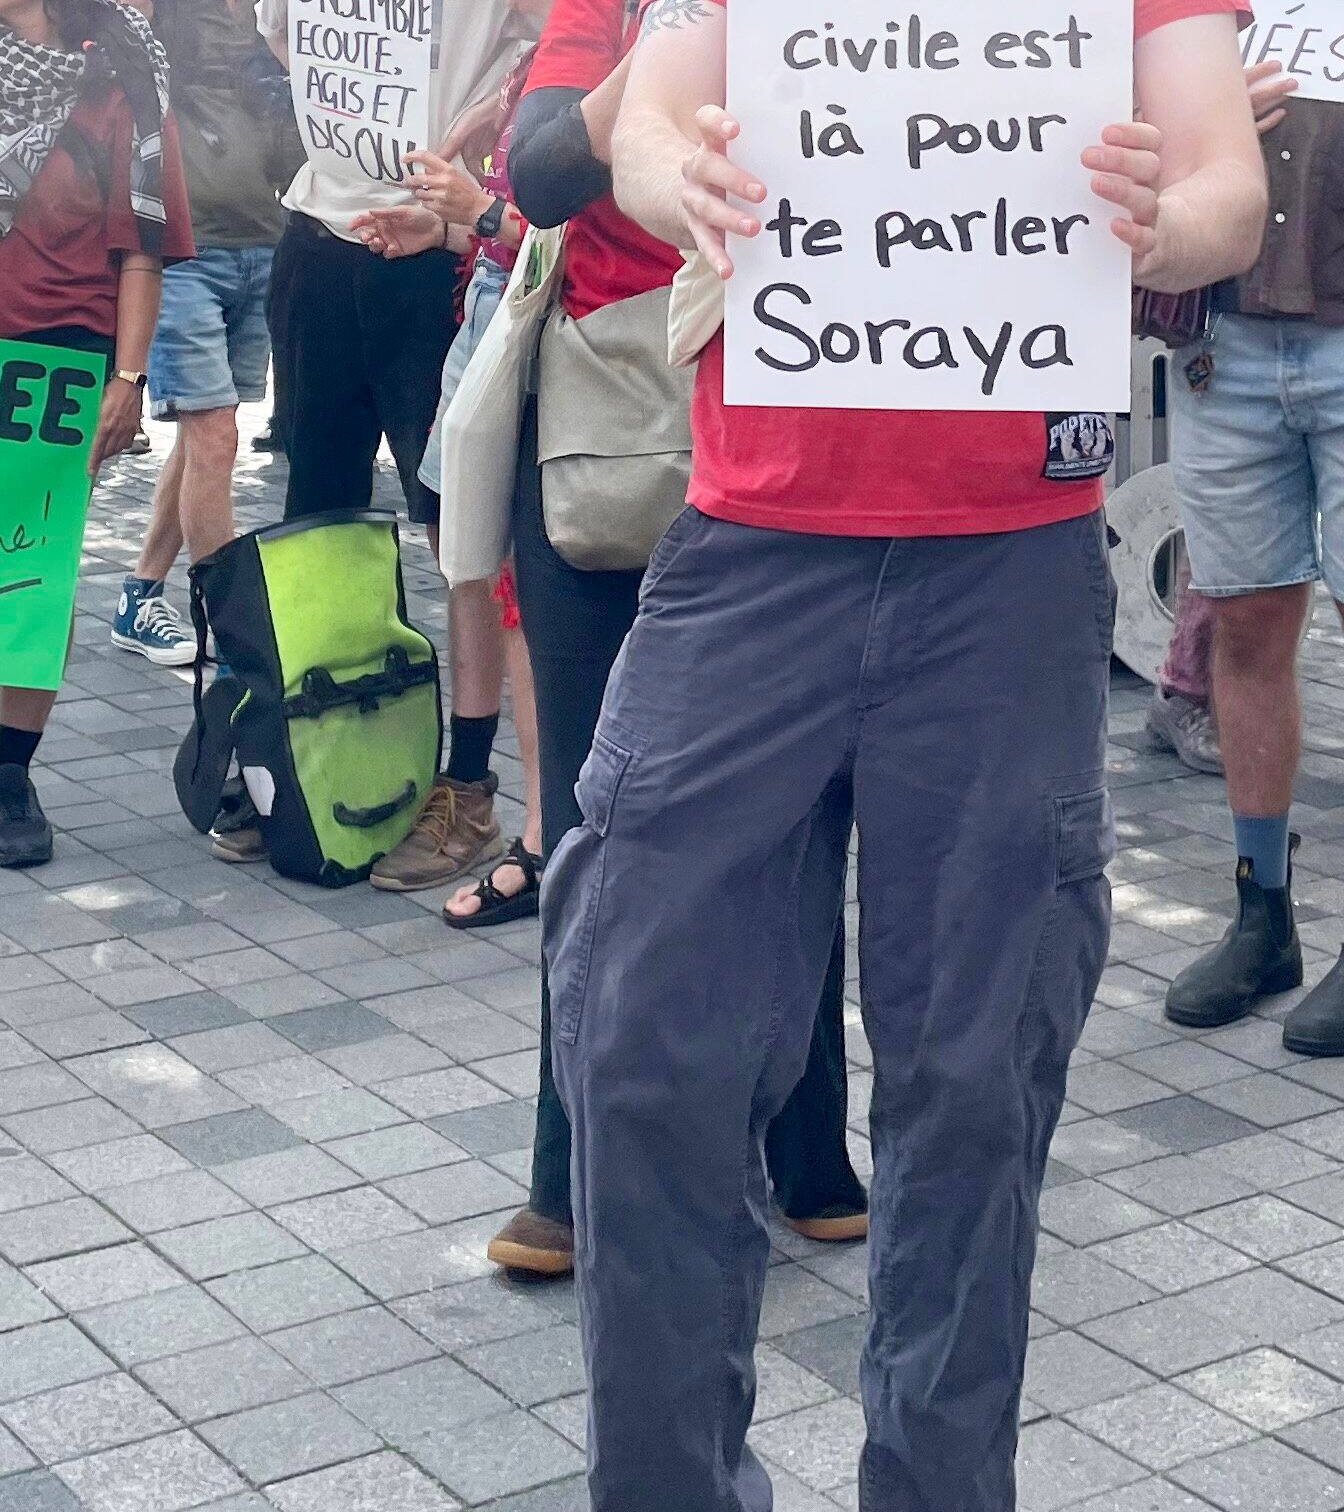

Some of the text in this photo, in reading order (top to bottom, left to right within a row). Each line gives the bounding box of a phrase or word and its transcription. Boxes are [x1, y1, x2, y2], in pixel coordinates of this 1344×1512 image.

[783, 13, 1092, 72] civile est
[306, 66, 417, 127] AGIS ET
[306, 114, 352, 158] DIS
[800, 103, 1066, 169] là pour
[765, 196, 1089, 268] te parler
[753, 282, 1074, 395] Soraya
